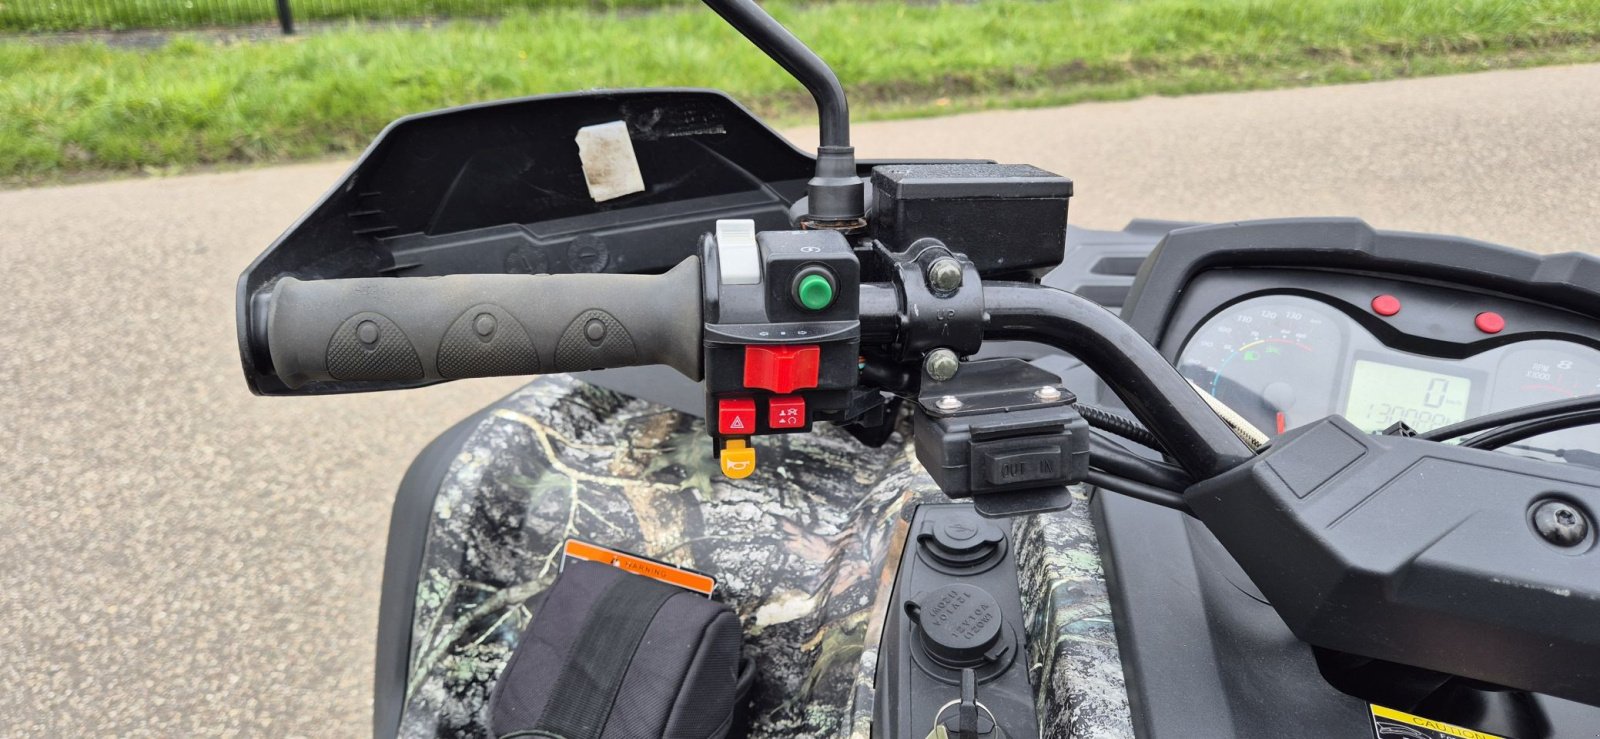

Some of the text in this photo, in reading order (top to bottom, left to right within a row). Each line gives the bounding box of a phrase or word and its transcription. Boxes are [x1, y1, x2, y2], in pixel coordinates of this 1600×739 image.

[1237, 314, 1253, 324] 110
[1261, 310, 1277, 320] 120
[1286, 311, 1302, 321] 130
[1556, 360, 1573, 370] 8
[1423, 378, 1450, 408] 0
[1001, 459, 1053, 479] OUT IN
[624, 560, 668, 578] WARNING
[1412, 717, 1486, 739] CAUTION
